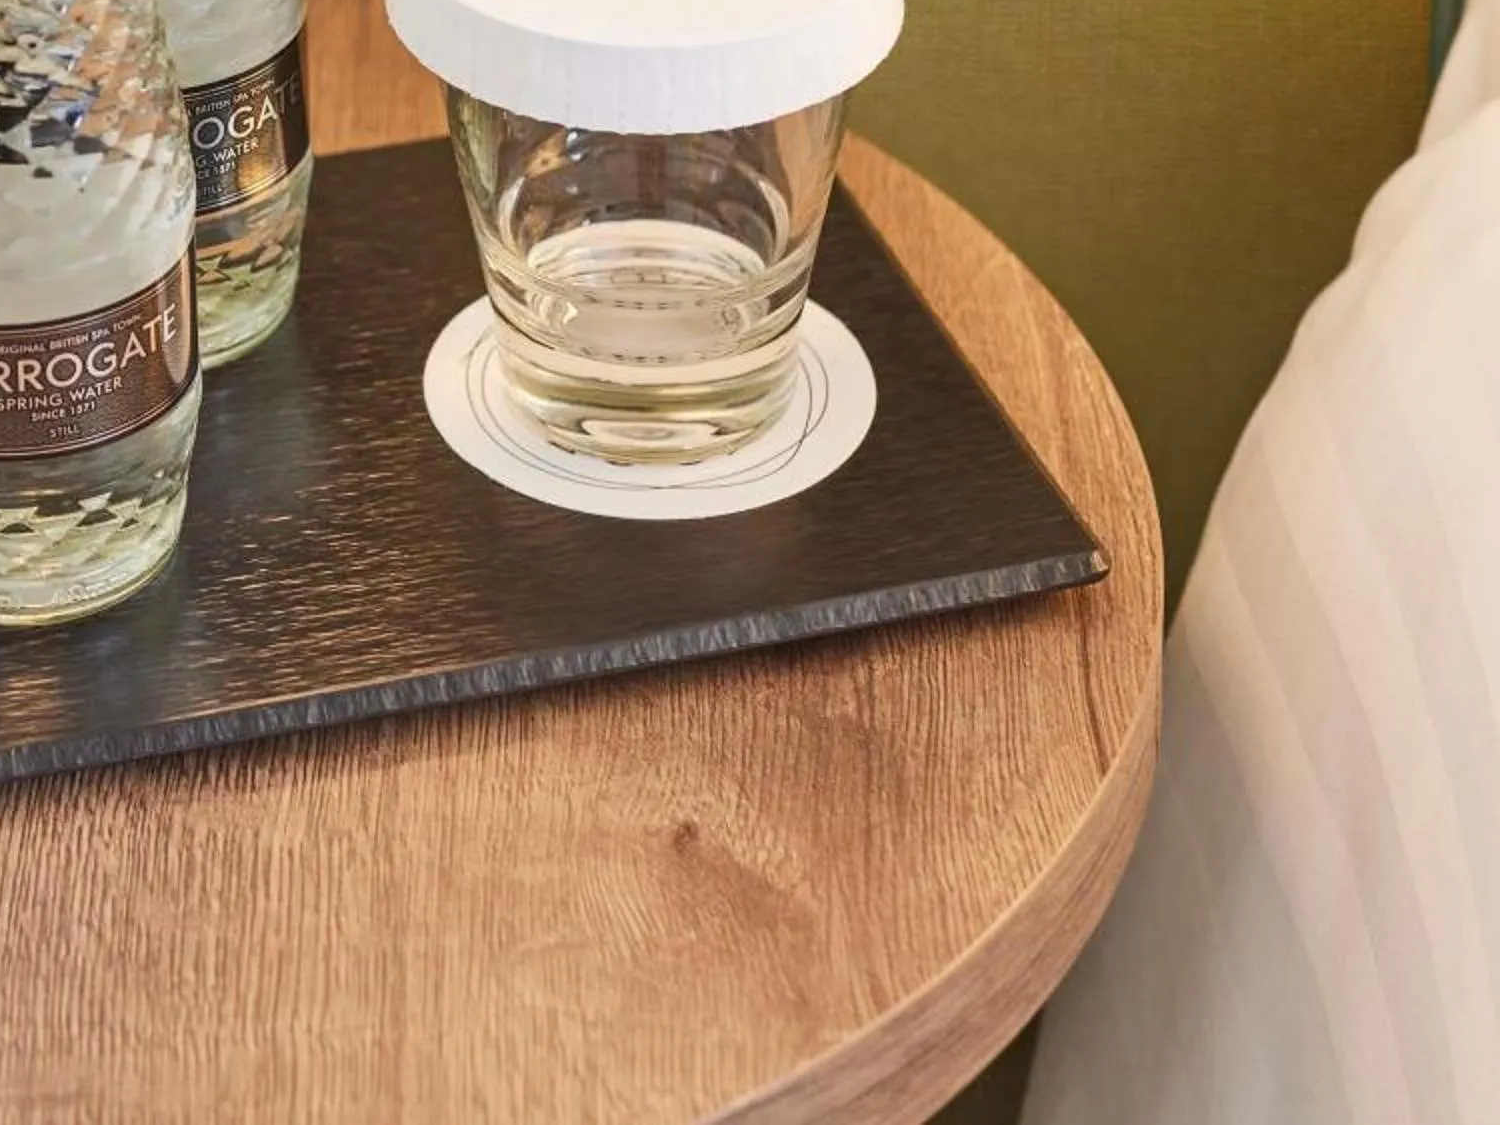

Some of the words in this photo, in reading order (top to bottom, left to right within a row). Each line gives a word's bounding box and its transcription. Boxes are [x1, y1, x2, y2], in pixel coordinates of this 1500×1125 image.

[192, 71, 299, 150] OGATE
[213, 136, 259, 162] WATER
[50, 333, 89, 350] BRITISH
[91, 328, 110, 342] SPA
[69, 376, 123, 401] WATER
[31, 408, 66, 422] SINCE
[49, 424, 80, 438] STILL
